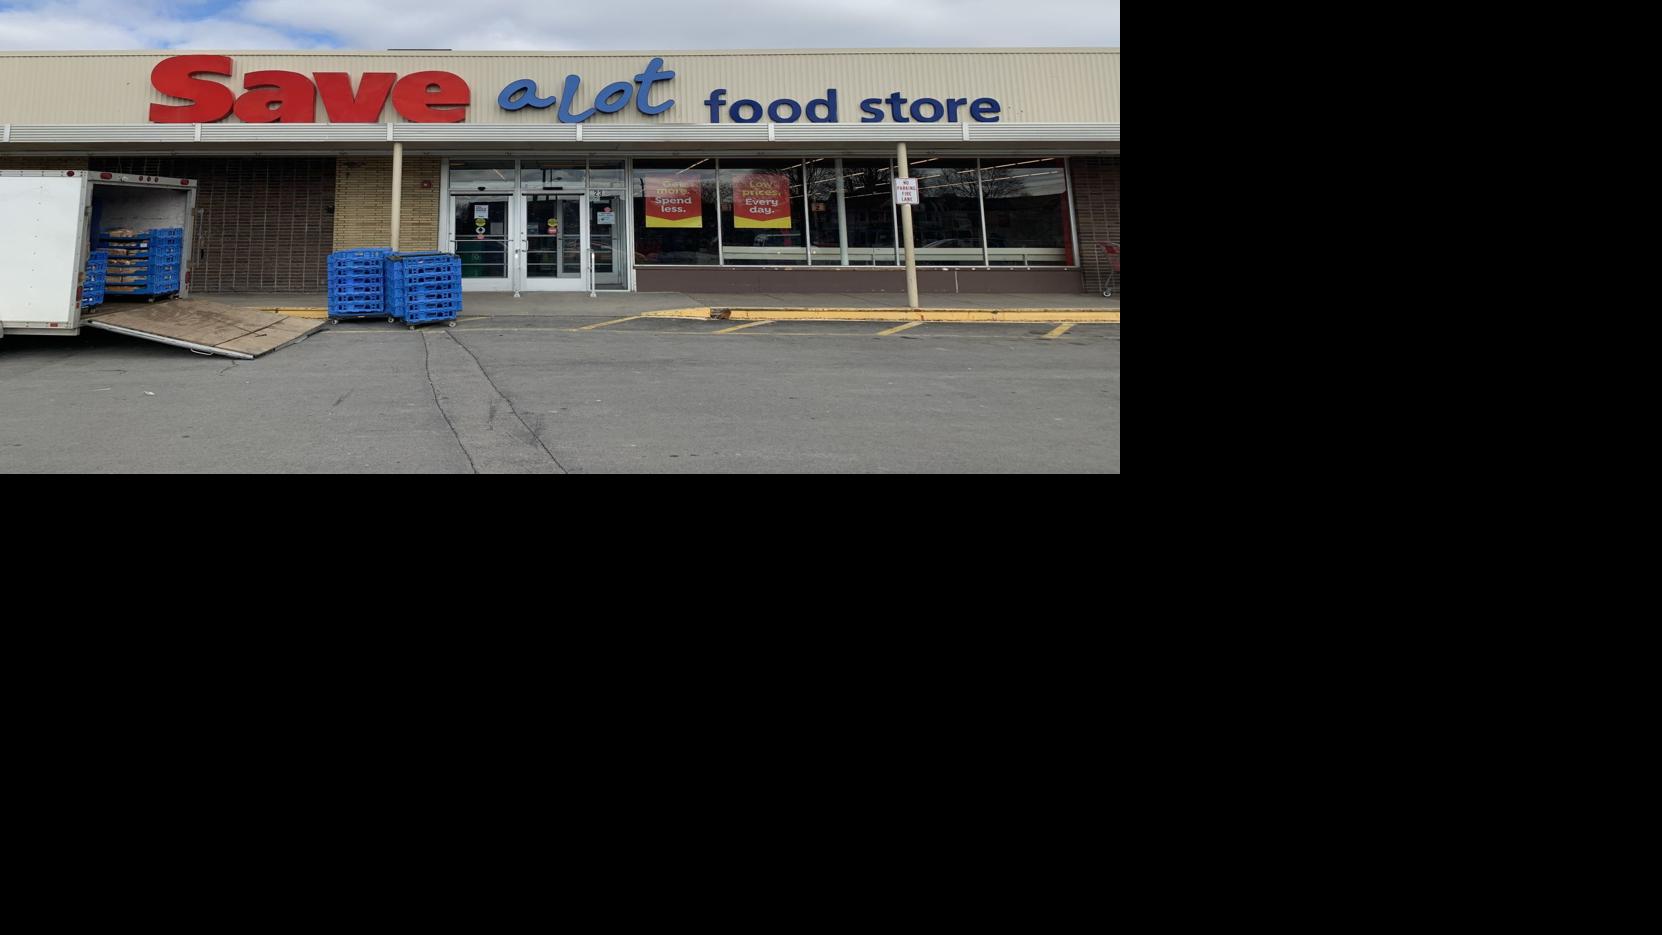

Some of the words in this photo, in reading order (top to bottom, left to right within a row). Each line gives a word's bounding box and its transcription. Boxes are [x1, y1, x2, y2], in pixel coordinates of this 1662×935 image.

[149, 54, 471, 123] Save
[704, 88, 838, 123] food
[859, 91, 1001, 123] store
[655, 196, 692, 205] Spend
[745, 198, 779, 206] Every
[661, 205, 687, 213] less.
[749, 205, 775, 215] day.
